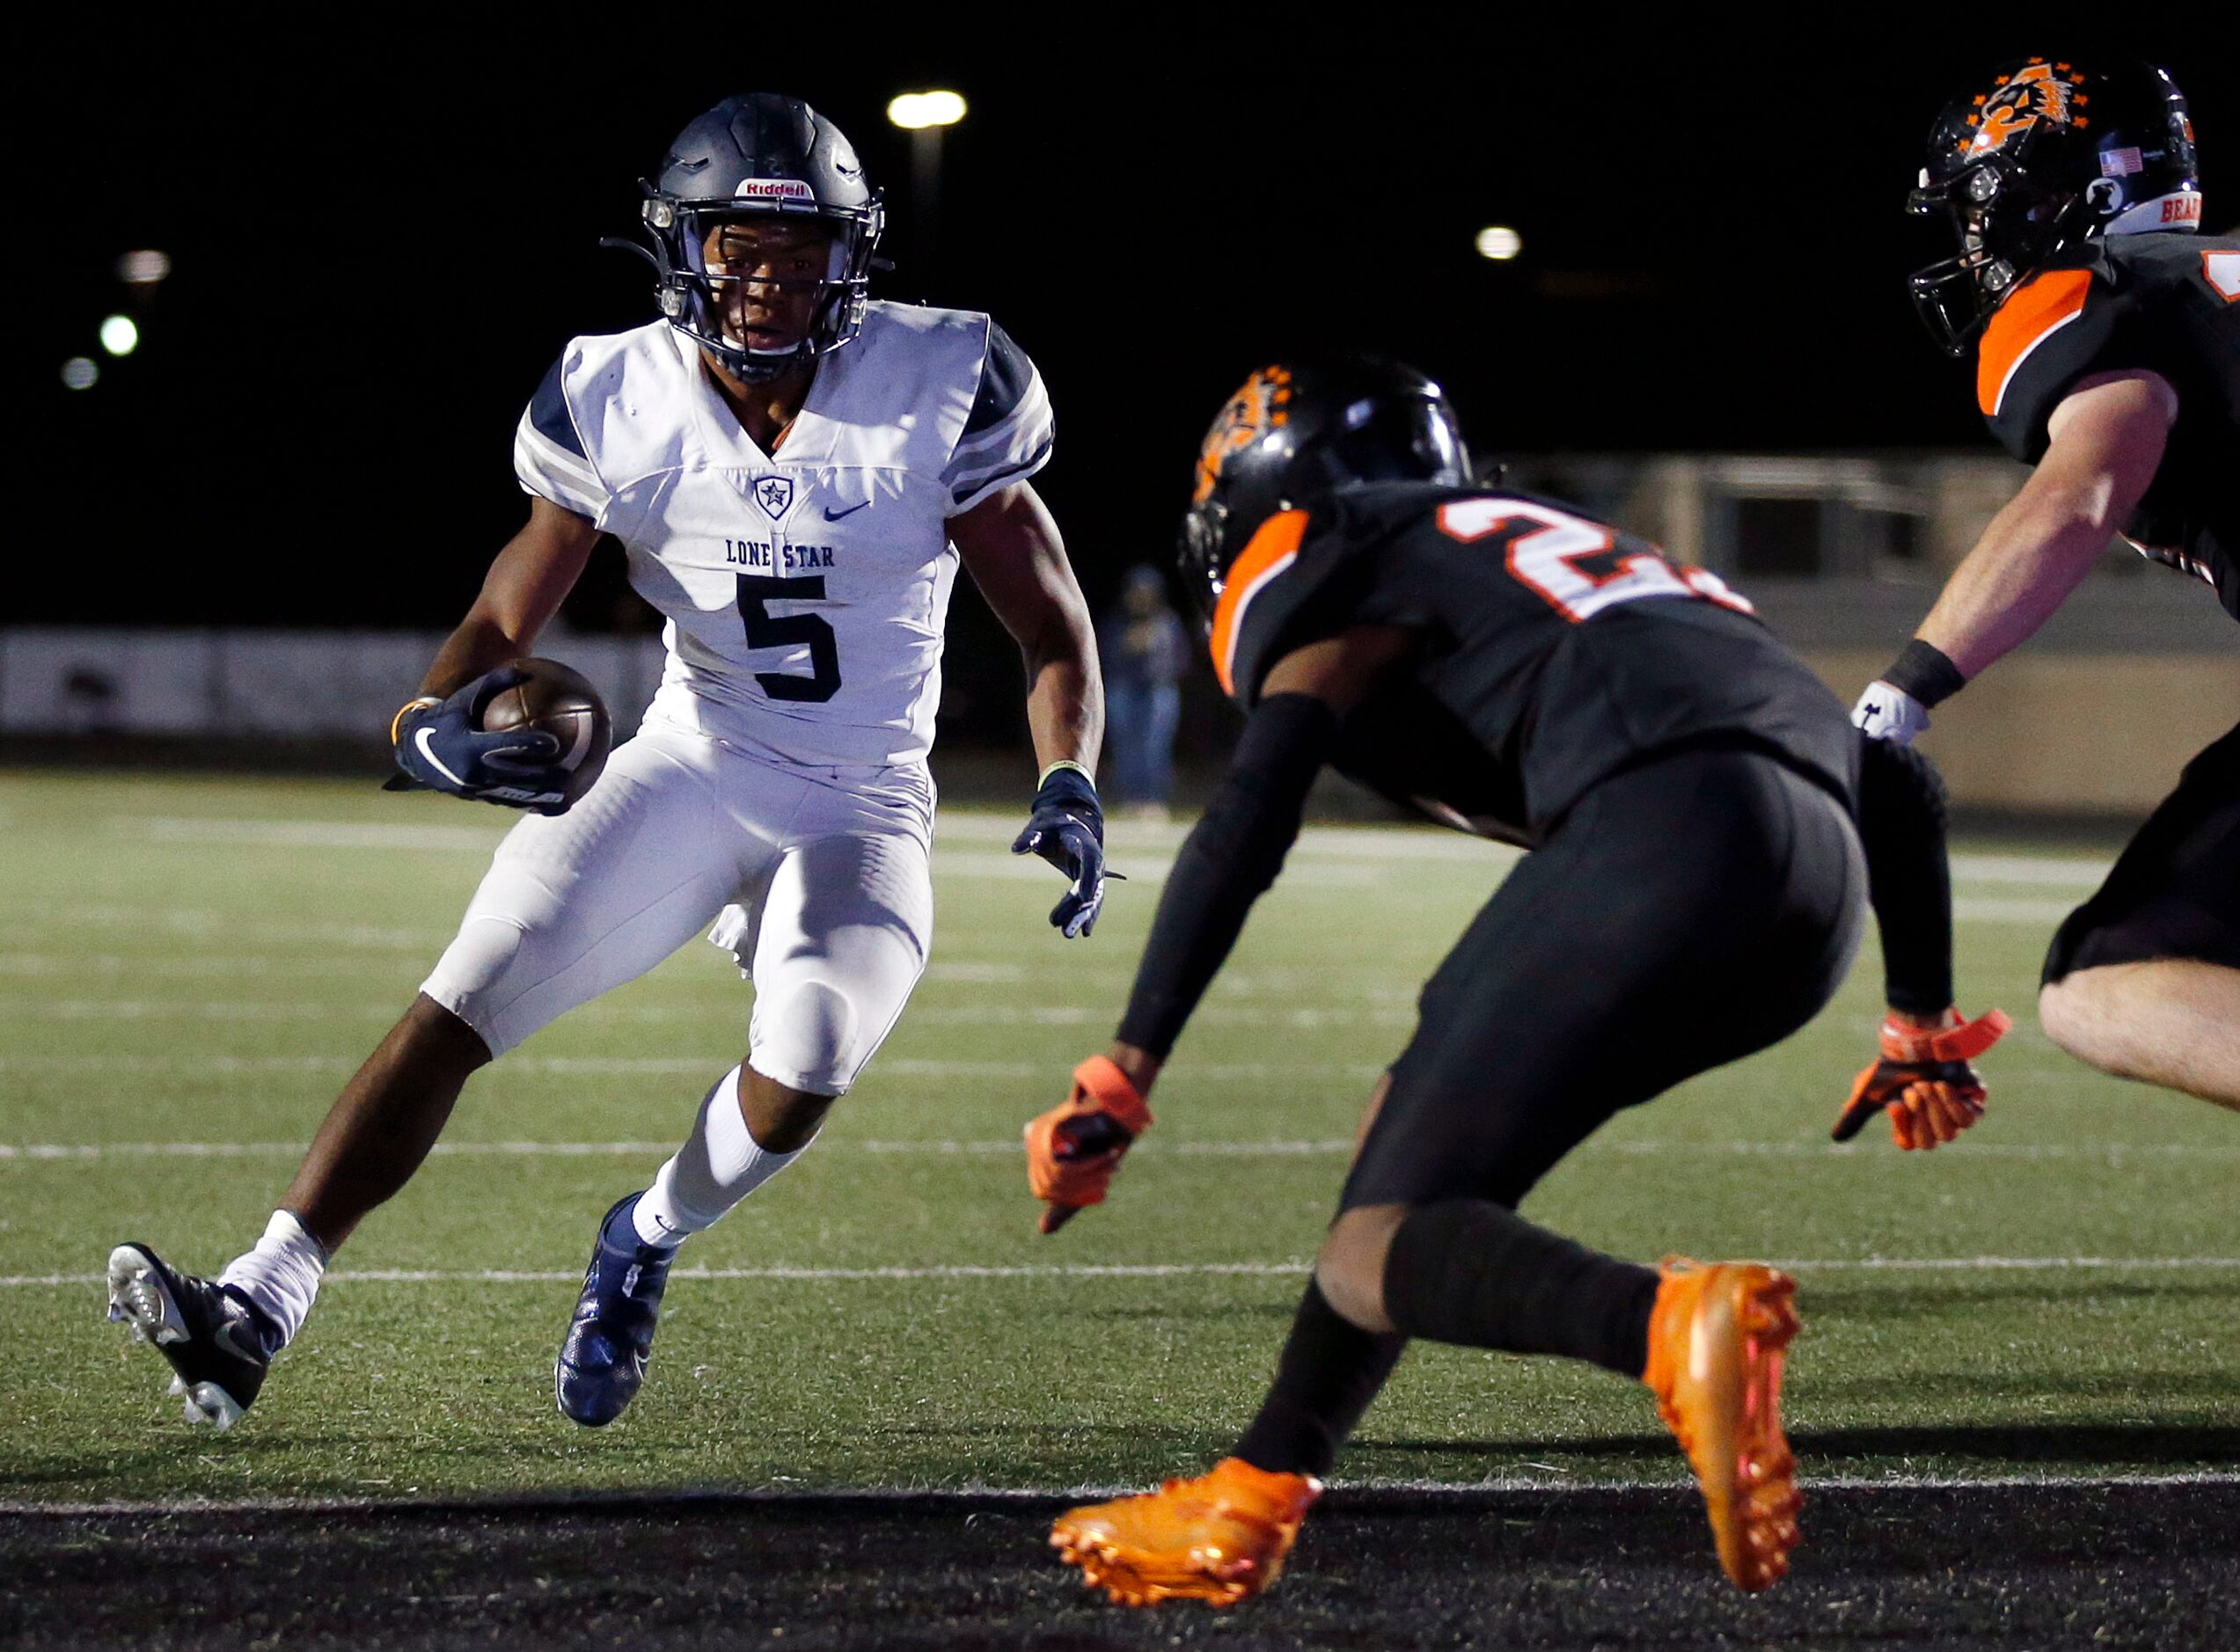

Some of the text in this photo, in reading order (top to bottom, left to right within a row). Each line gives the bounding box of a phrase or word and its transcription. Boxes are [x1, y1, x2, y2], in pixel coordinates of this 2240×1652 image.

[747, 184, 804, 195] Riddell
[726, 539, 834, 567] LONE STAR
[1437, 499, 1756, 623] 2
[736, 574, 842, 702] 5
